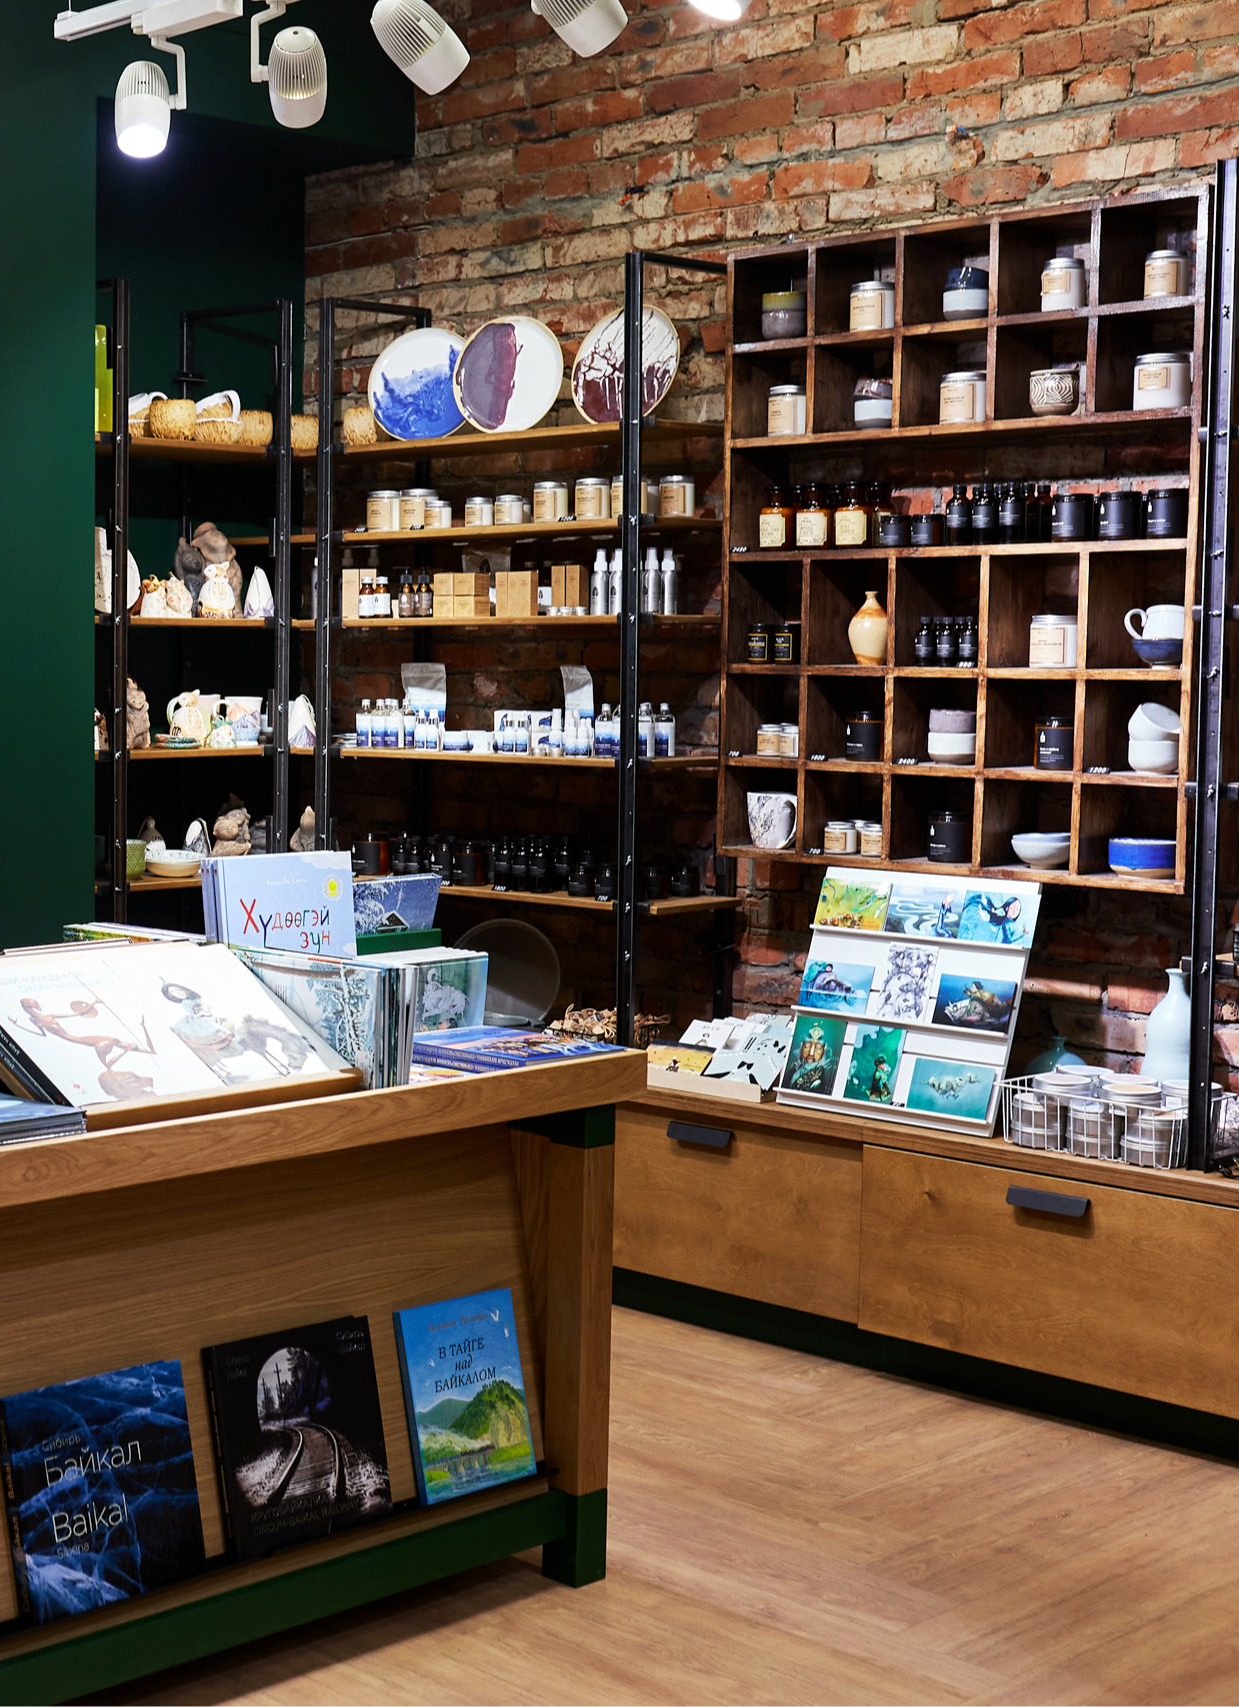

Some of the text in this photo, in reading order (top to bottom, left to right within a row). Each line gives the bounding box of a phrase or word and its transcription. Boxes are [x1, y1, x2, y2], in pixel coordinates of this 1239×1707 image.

[439, 1336, 485, 1359] В ТАЙГЕ
[225, 1355, 250, 1368] Siberia
[455, 1353, 473, 1371] над
[435, 1366, 496, 1393] БАЙКАЛОМ
[41, 1434, 81, 1453] Сибирь
[44, 1440, 142, 1487] Байкал
[4, 1462, 15, 1500] Baikal
[52, 1492, 129, 1543] Baikal
[251, 1494, 329, 1524] КРУГОБАЙКАЛКА
[252, 1510, 321, 1537] CIRCUM-BAIKAL
[321, 1498, 360, 1518] RAILWAY
[57, 1541, 90, 1560] Siberia
